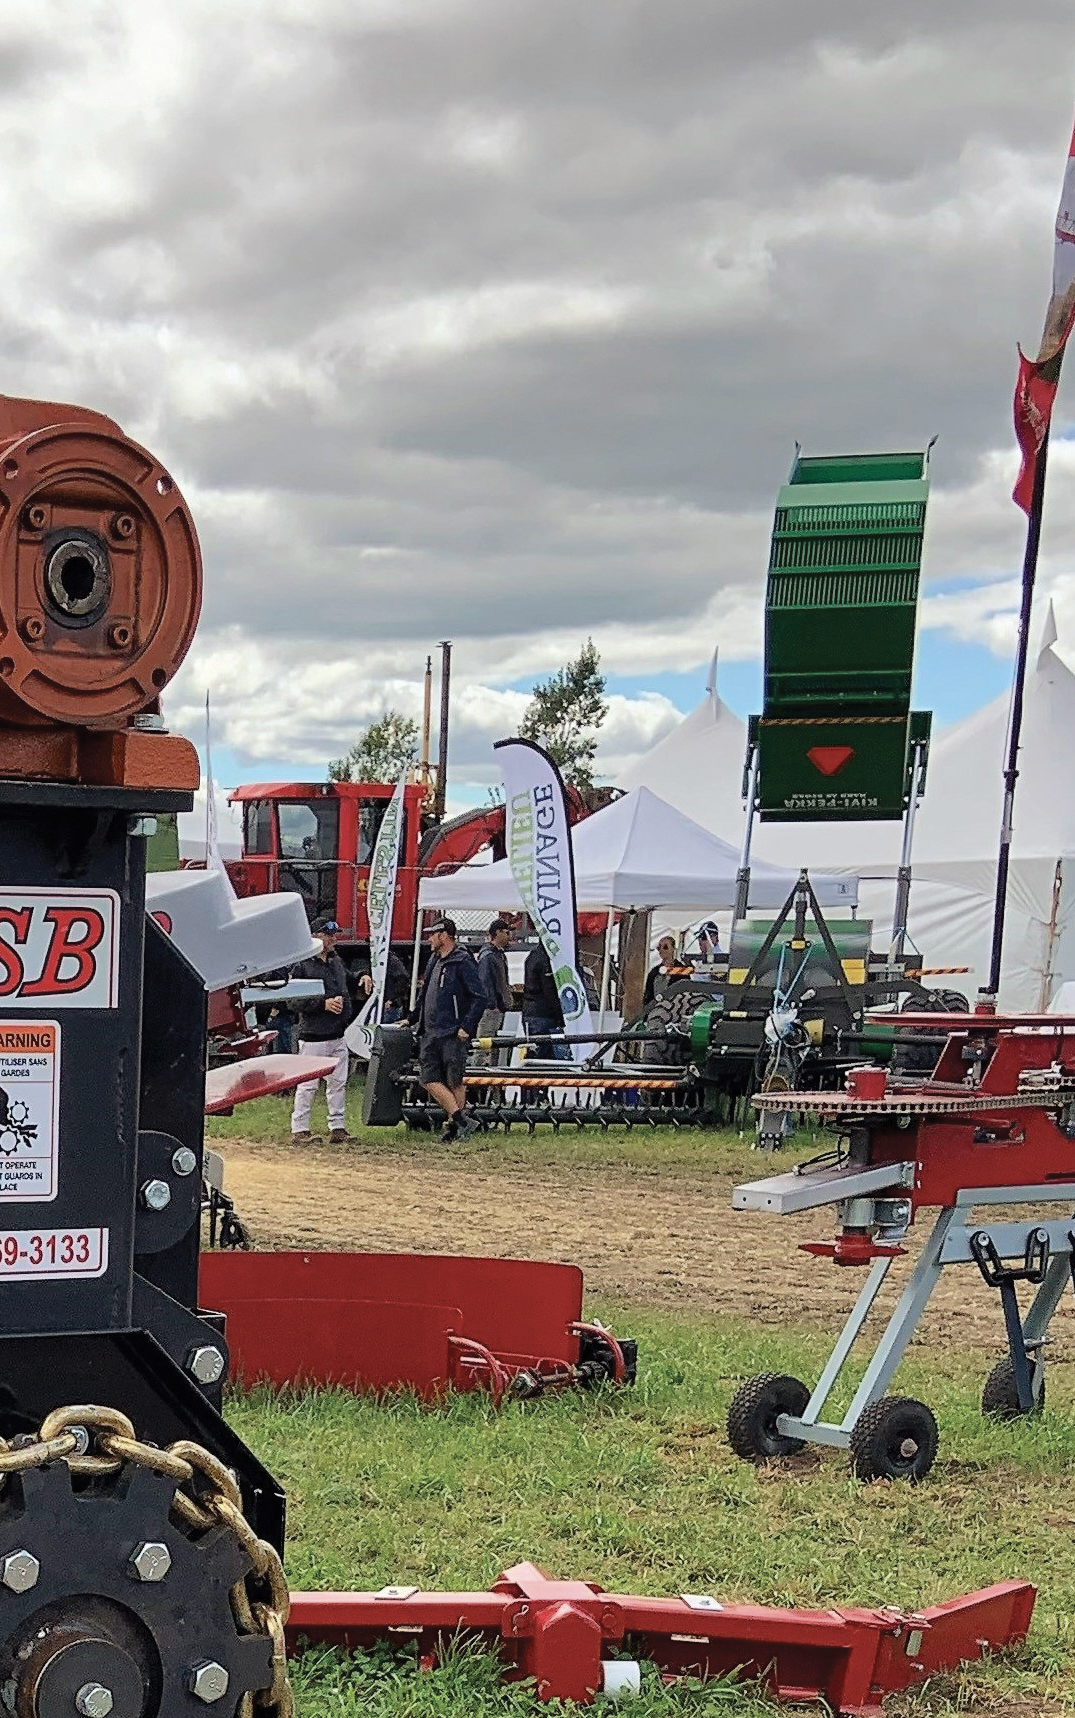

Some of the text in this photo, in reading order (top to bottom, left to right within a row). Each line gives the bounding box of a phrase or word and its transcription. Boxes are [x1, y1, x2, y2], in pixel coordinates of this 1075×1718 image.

[28, 1058, 48, 1066] SANS
[1, 1069, 30, 1077] GARDES
[5, 1161, 37, 1169] OPERATE
[4, 1172, 33, 1180] GUARDS
[35, 1172, 43, 1180] IN
